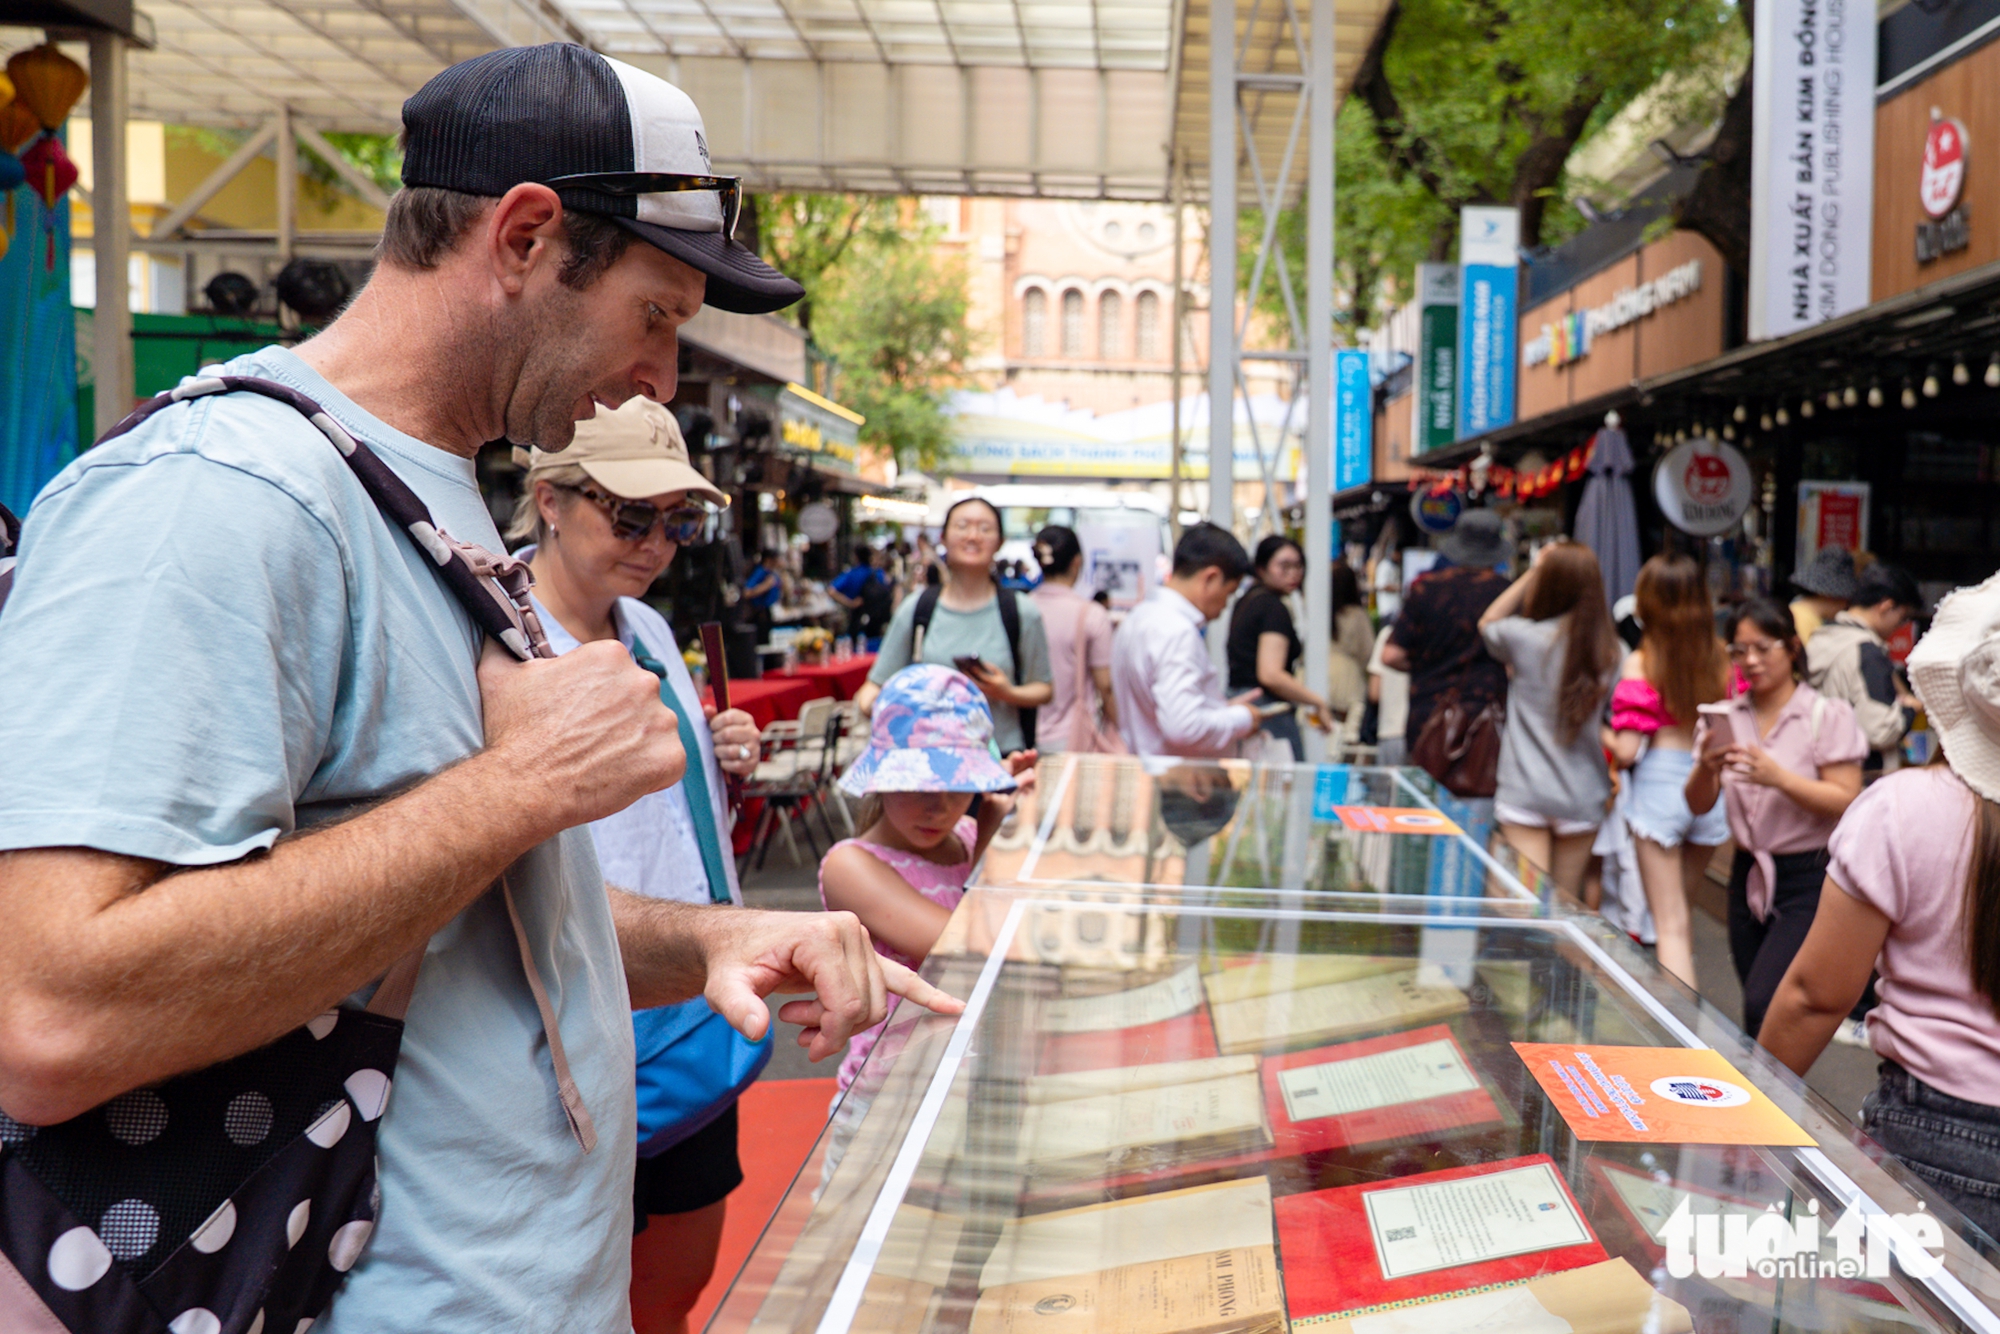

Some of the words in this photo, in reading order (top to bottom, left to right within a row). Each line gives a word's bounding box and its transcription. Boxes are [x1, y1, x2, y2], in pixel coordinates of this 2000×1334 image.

[1797, 76, 1815, 124] KIM
[1821, 70, 1842, 197] PUBLISHING
[1788, 192, 1811, 257] XUẤT
[1788, 265, 1810, 321] NHÀ
[1217, 1273, 1236, 1317] PHONG
